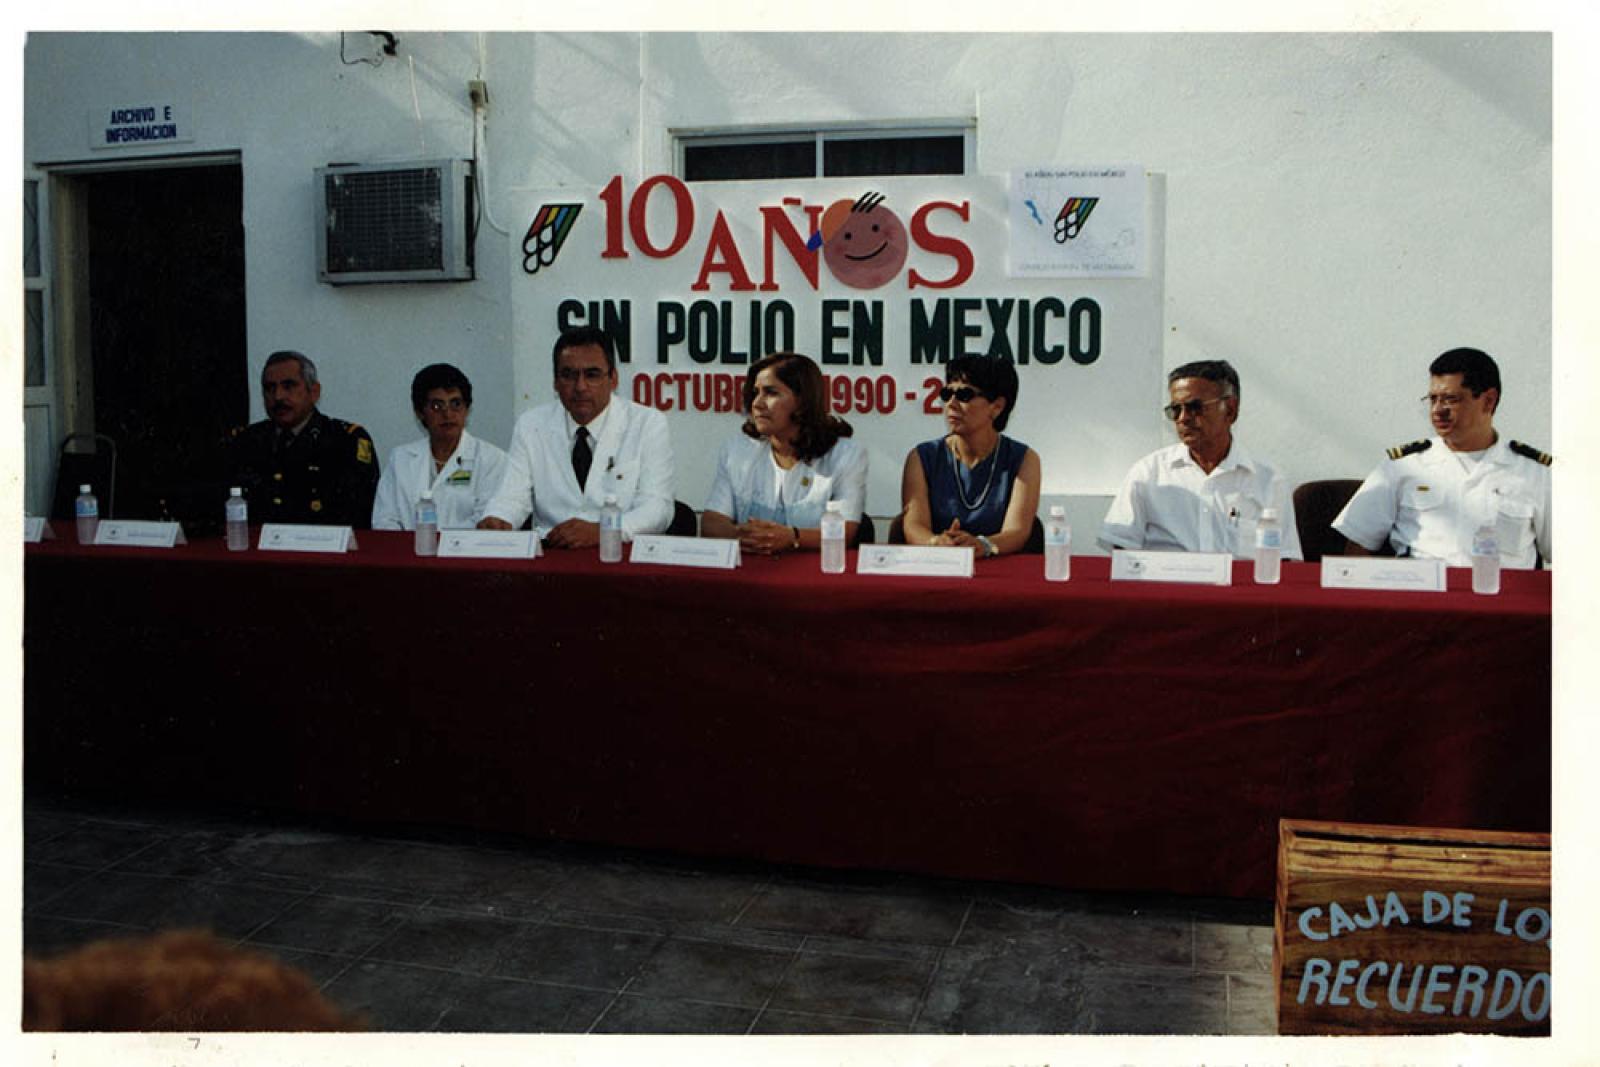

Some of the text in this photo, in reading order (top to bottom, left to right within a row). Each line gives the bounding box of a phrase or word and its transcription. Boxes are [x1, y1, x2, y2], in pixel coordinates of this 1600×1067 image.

[105, 124, 177, 143] INFORMACION
[110, 105, 172, 124] ARCHIVO E
[598, 174, 695, 260] 10
[658, 299, 795, 365] POLIO
[822, 299, 884, 366] EN
[910, 297, 1102, 366] MEXICO
[632, 372, 748, 413] OCTUB
[821, 375, 897, 415] 1990
[1298, 890, 1552, 950] CAJA DE LO
